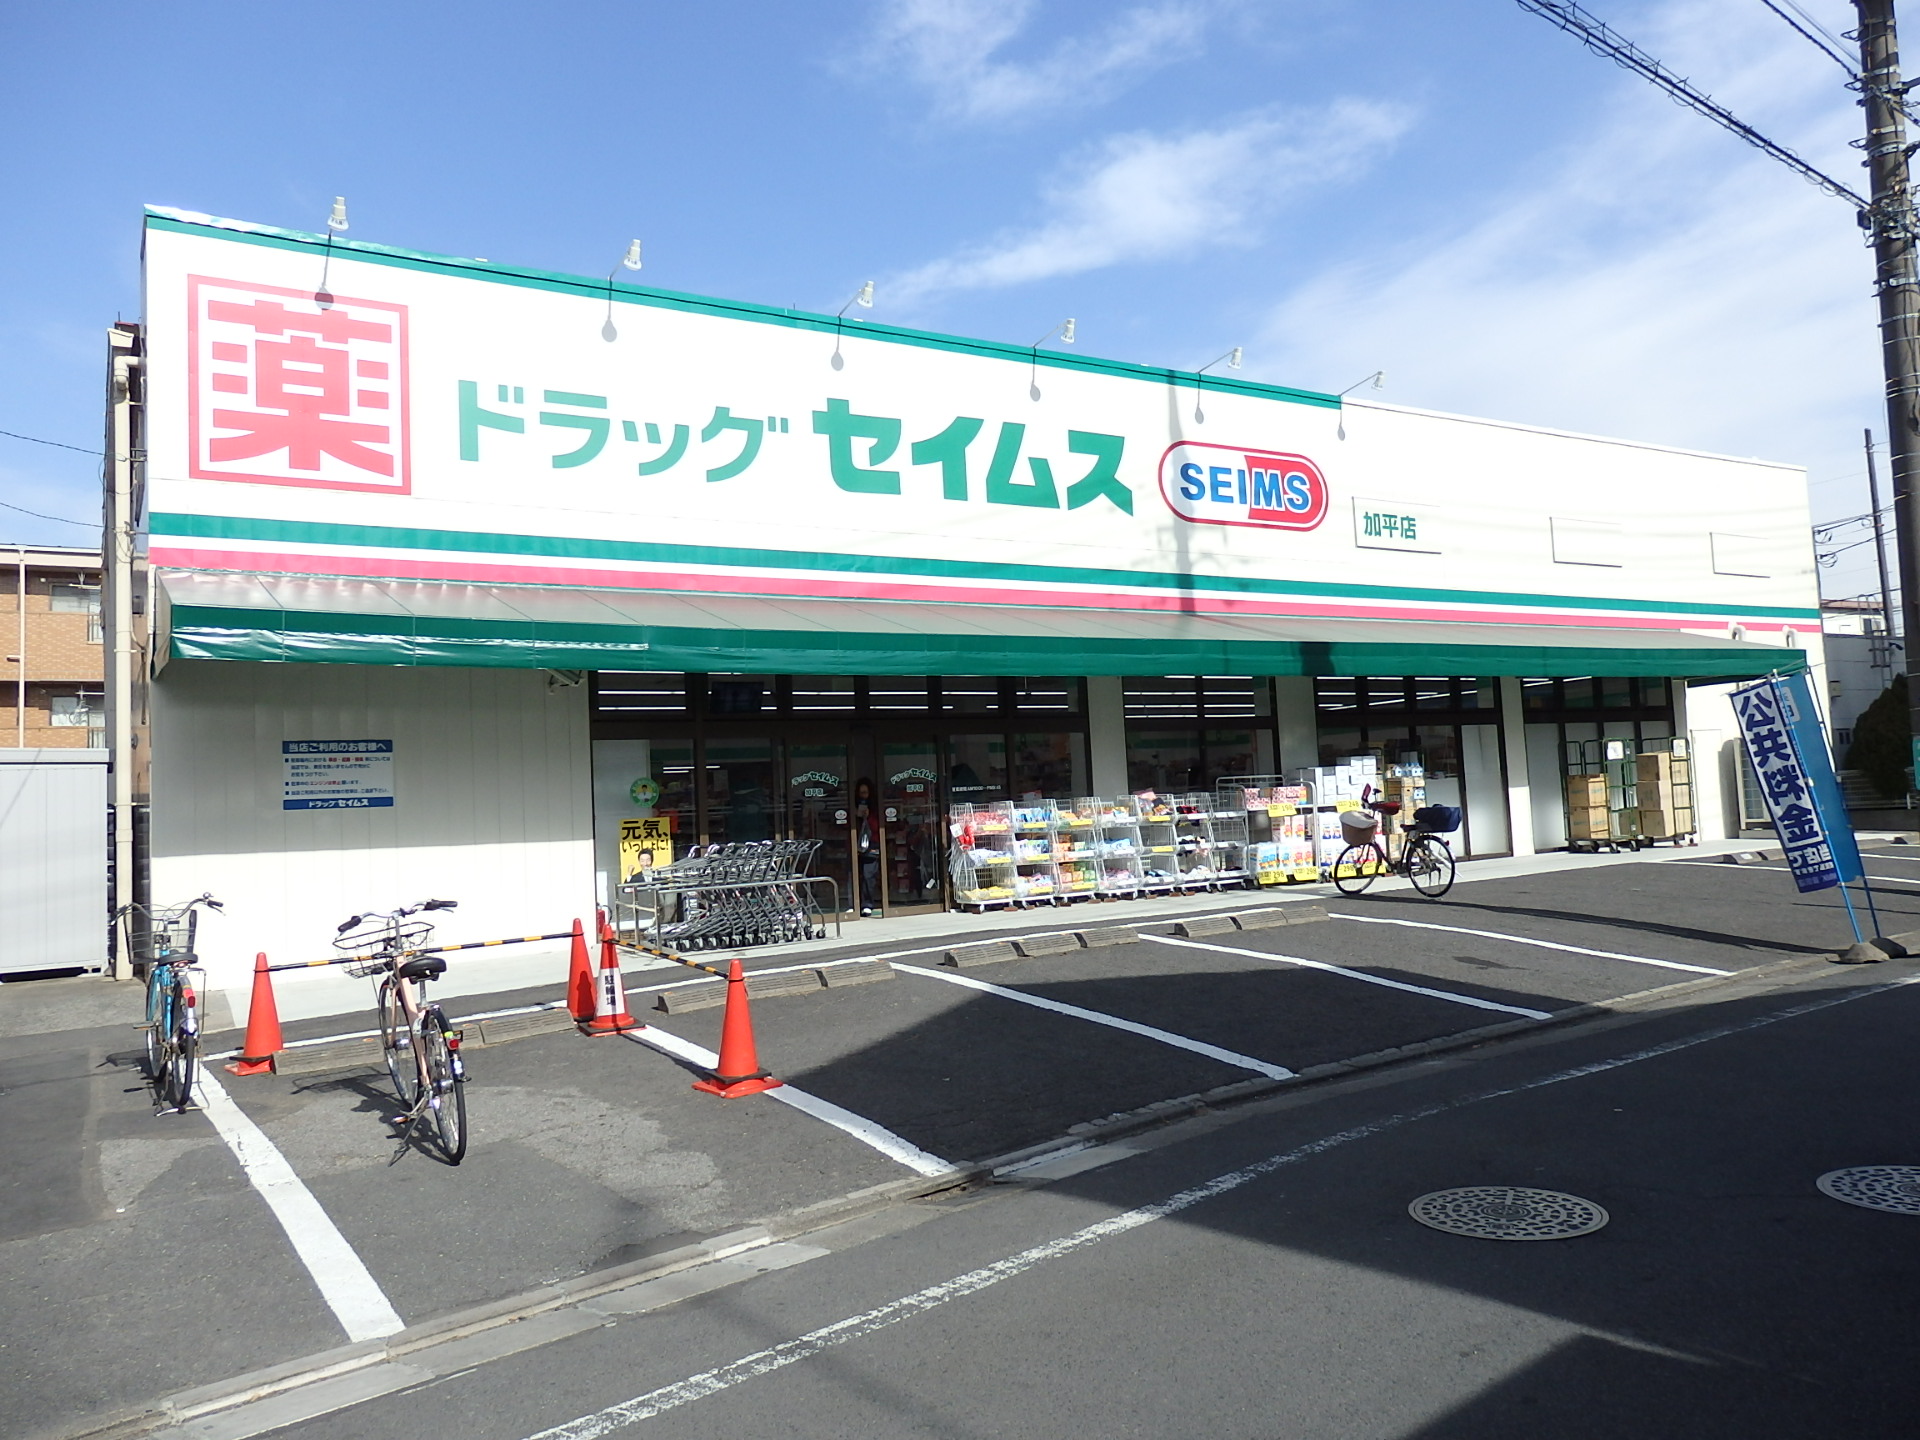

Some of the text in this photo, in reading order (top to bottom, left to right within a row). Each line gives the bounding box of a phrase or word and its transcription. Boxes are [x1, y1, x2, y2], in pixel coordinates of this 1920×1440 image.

[207, 299, 394, 478] 薬
[1179, 462, 1310, 512] SEIMS
[1363, 512, 1417, 540] 加平店
[621, 819, 669, 840] 元気、
